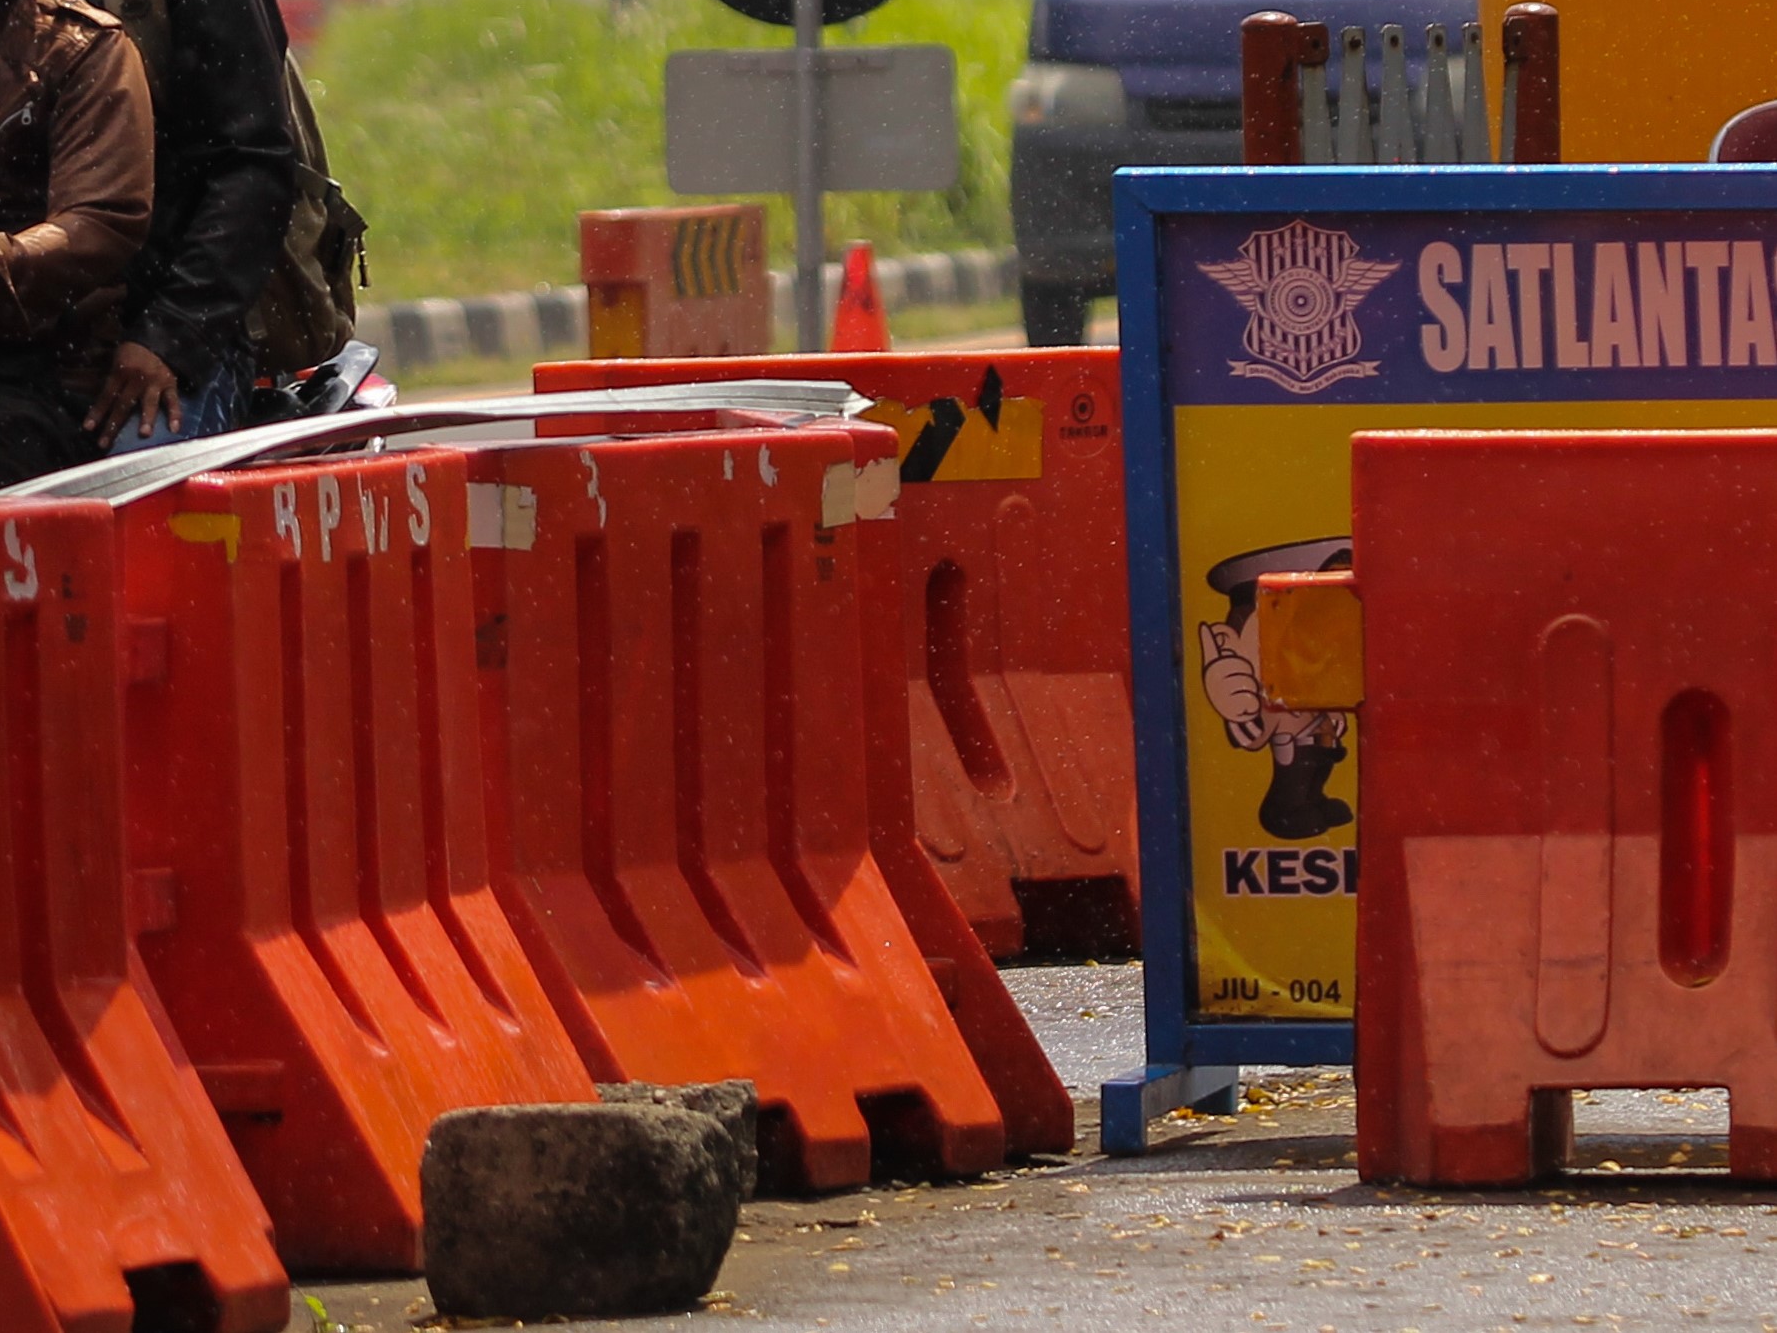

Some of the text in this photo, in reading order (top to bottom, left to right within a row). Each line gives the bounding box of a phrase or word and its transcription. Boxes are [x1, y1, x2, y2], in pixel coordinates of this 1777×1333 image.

[1418, 240, 1777, 373] SATLANTA
[1214, 977, 1260, 1002] JIU
[1289, 978, 1342, 1004] 004
